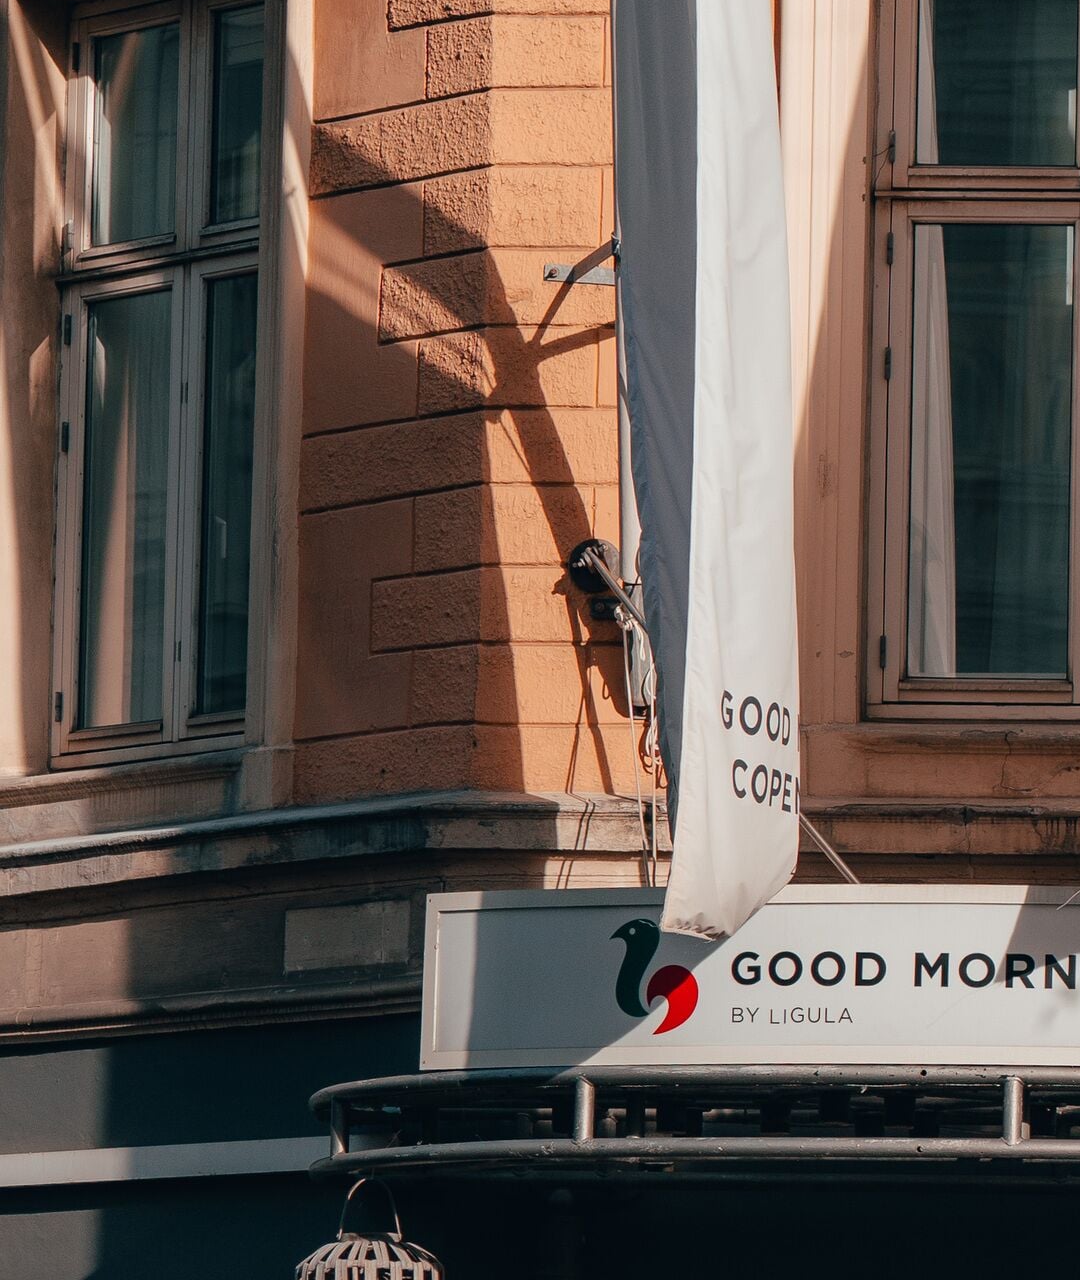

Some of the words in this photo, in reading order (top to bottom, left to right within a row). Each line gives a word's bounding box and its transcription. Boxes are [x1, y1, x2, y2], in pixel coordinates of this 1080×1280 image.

[721, 690, 790, 746] GOOD
[731, 951, 887, 987] GOOD
[731, 1007, 760, 1023] BY
[770, 1006, 853, 1025] LIGULA
